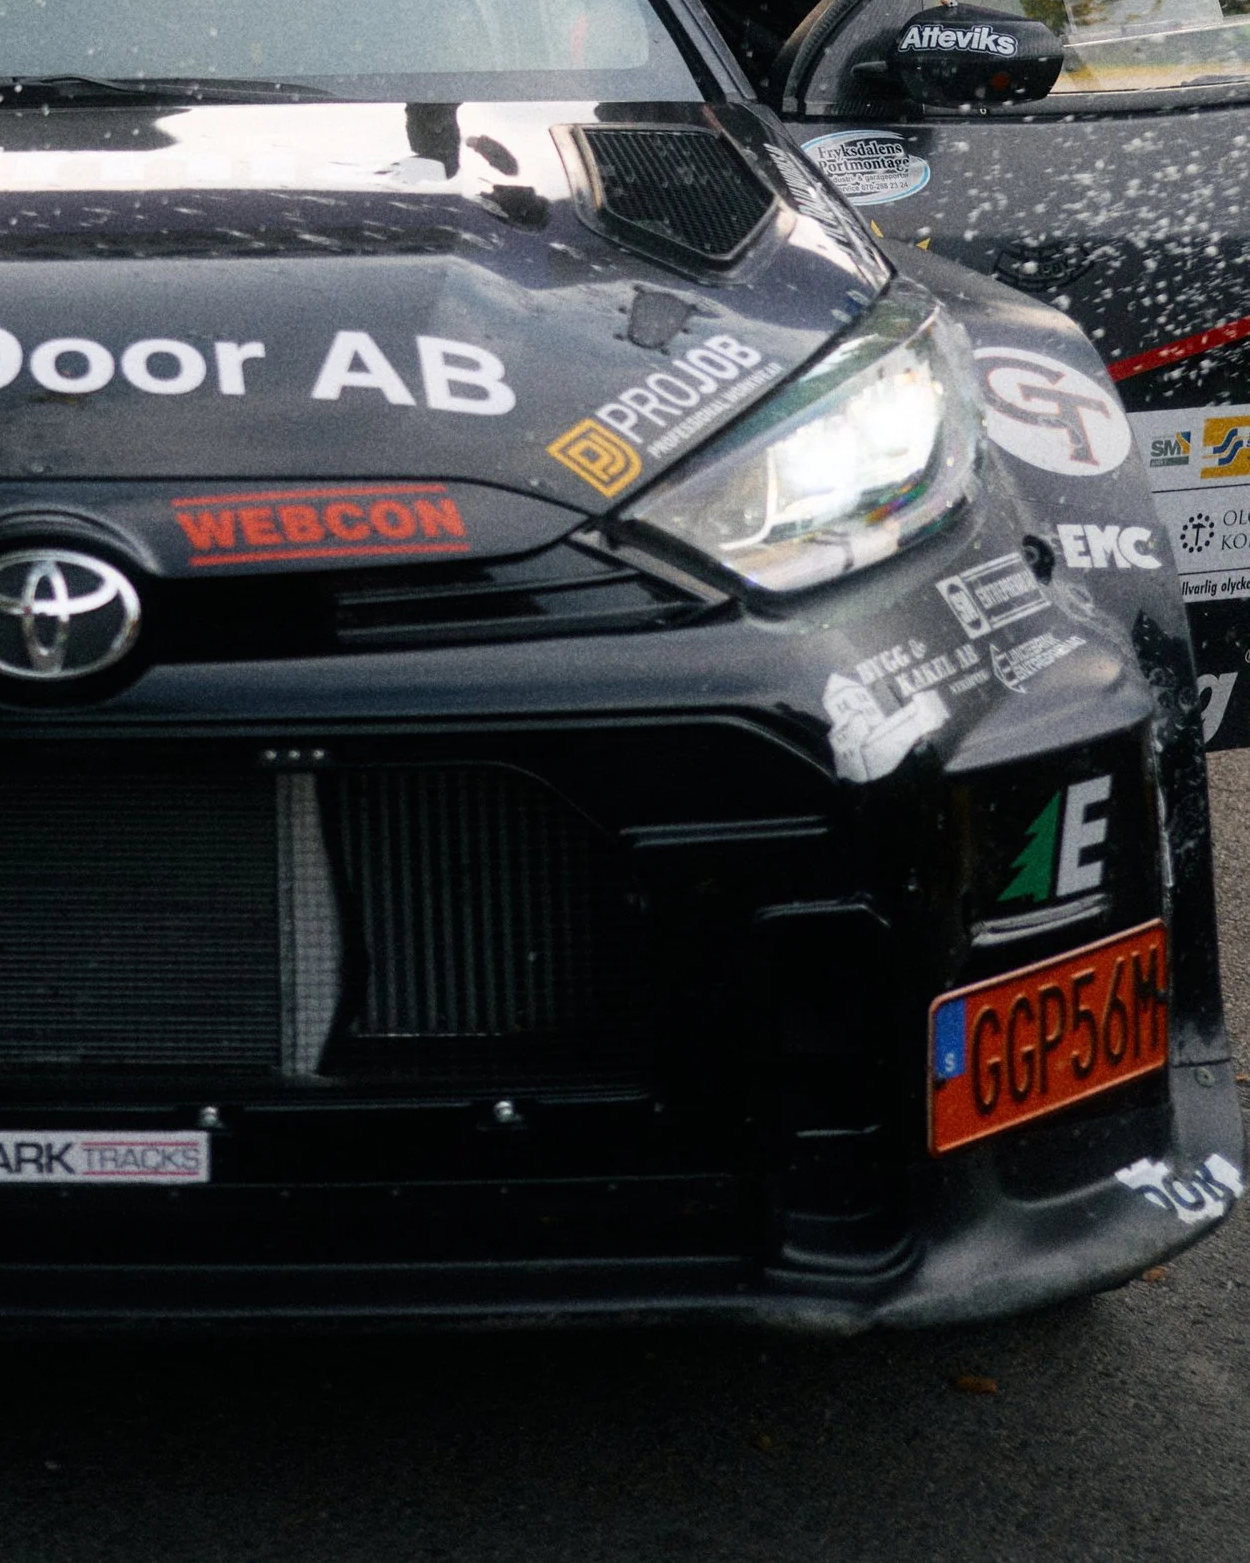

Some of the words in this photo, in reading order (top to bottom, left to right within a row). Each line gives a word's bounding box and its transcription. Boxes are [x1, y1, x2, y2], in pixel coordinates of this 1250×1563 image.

[900, 26, 1017, 57] Atteviks
[817, 141, 903, 162] Fryksdalens
[818, 157, 910, 174] Portmontage
[311, 330, 518, 416] AB
[595, 334, 763, 444] PROJOB
[1150, 439, 1182, 457] SM
[174, 498, 467, 550] WEBCON
[1056, 524, 1163, 570] EMC
[1181, 580, 1217, 597] llvarlig
[1055, 774, 1113, 898] E
[945, 1051, 955, 1073] S
[81, 1146, 200, 1172] TRACKS
